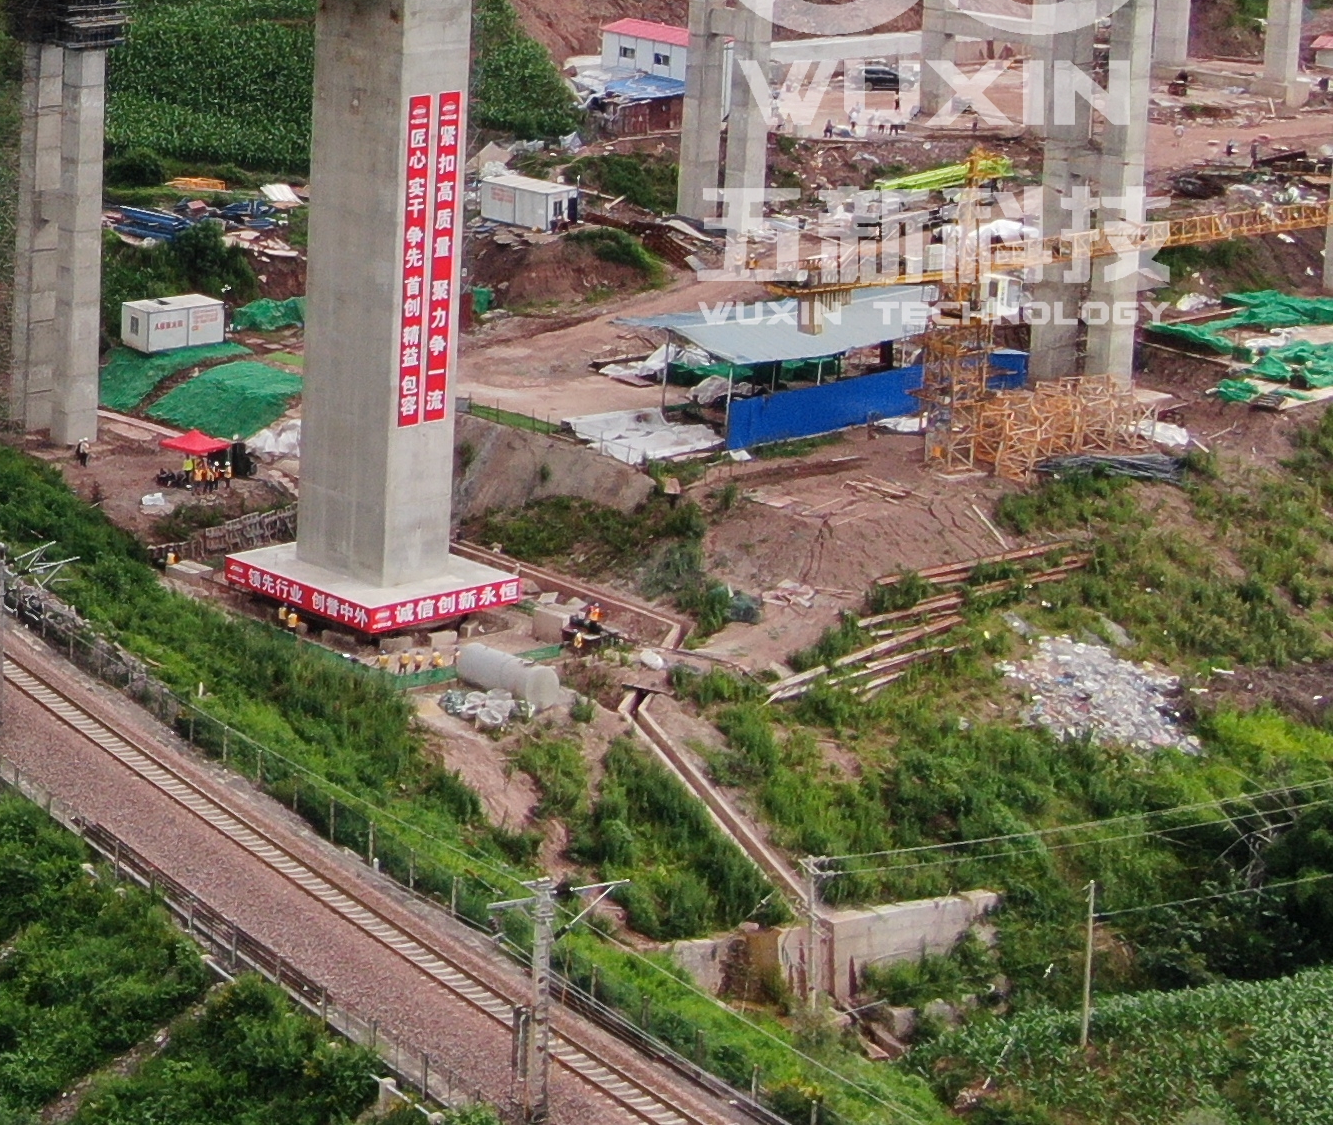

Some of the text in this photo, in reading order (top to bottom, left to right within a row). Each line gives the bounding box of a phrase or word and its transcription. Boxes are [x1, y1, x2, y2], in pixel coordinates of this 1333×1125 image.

[395, 582, 520, 624] 诚信创新永恒
